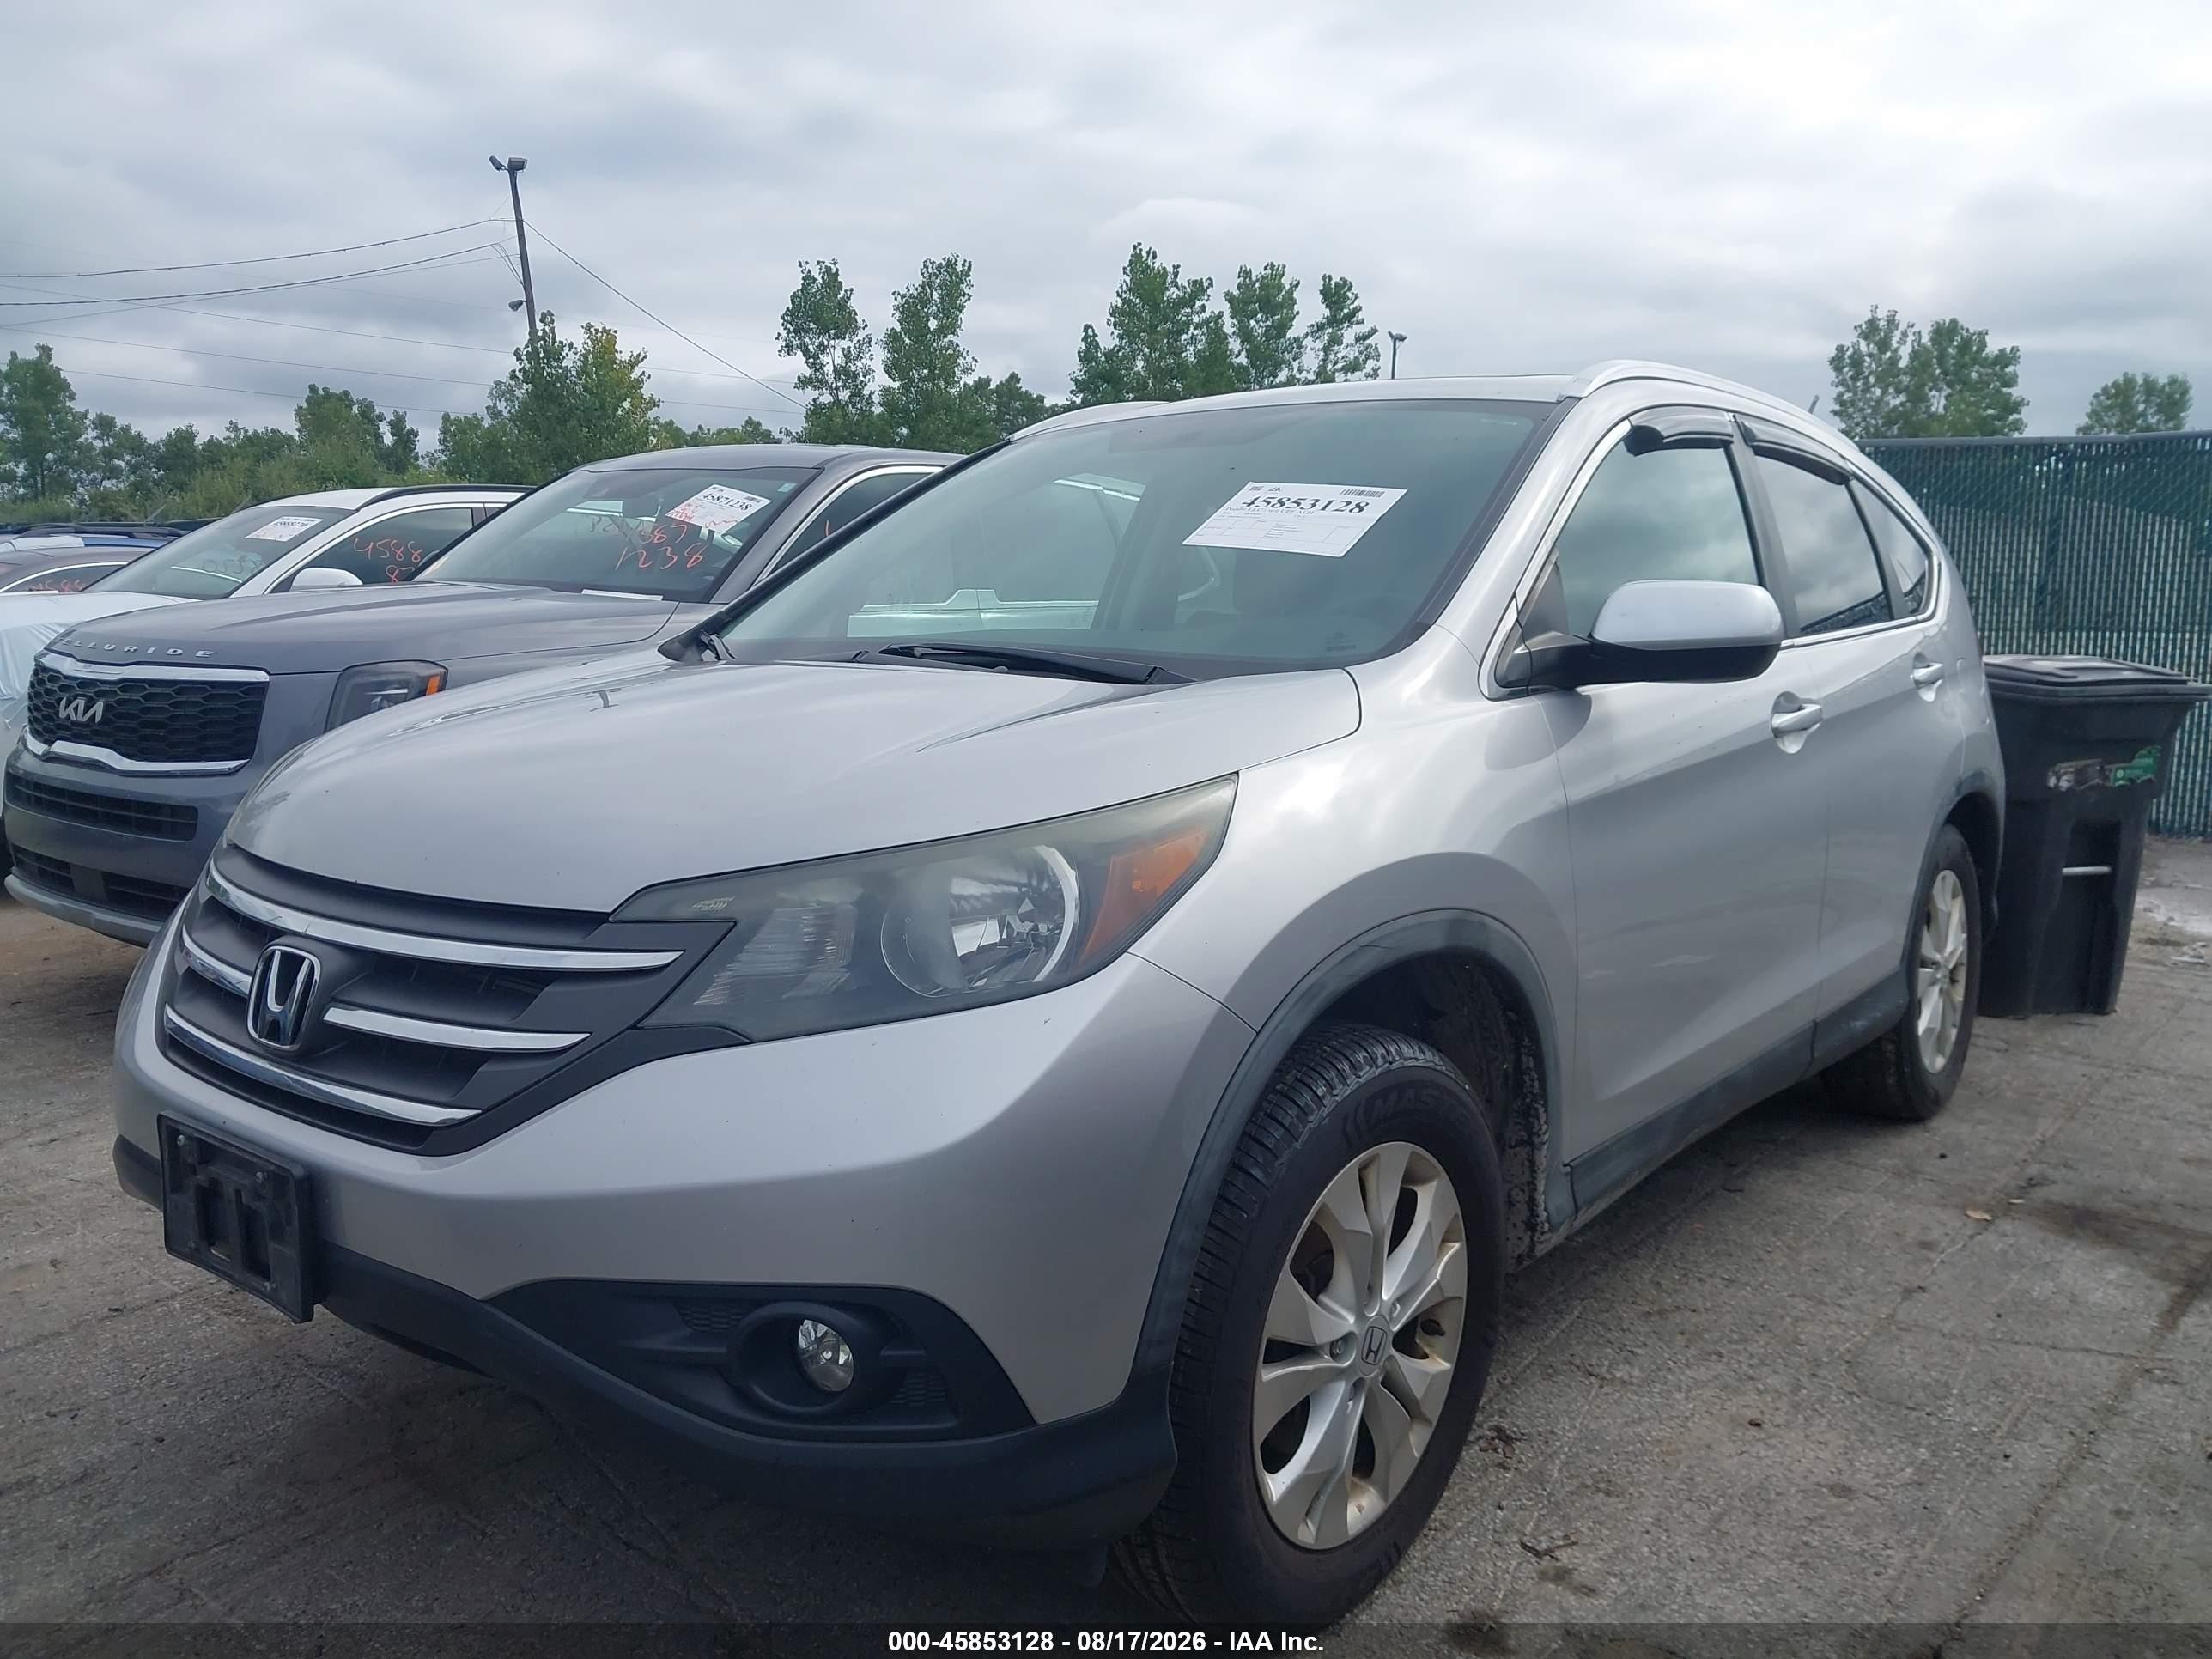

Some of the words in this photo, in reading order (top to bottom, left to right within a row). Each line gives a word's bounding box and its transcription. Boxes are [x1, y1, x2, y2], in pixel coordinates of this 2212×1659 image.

[703, 493, 752, 511] 45871238
[1242, 495, 1371, 514] 45853128
[353, 538, 423, 562] 4588
[614, 542, 710, 571] 1238
[58, 696, 104, 724] KIA
